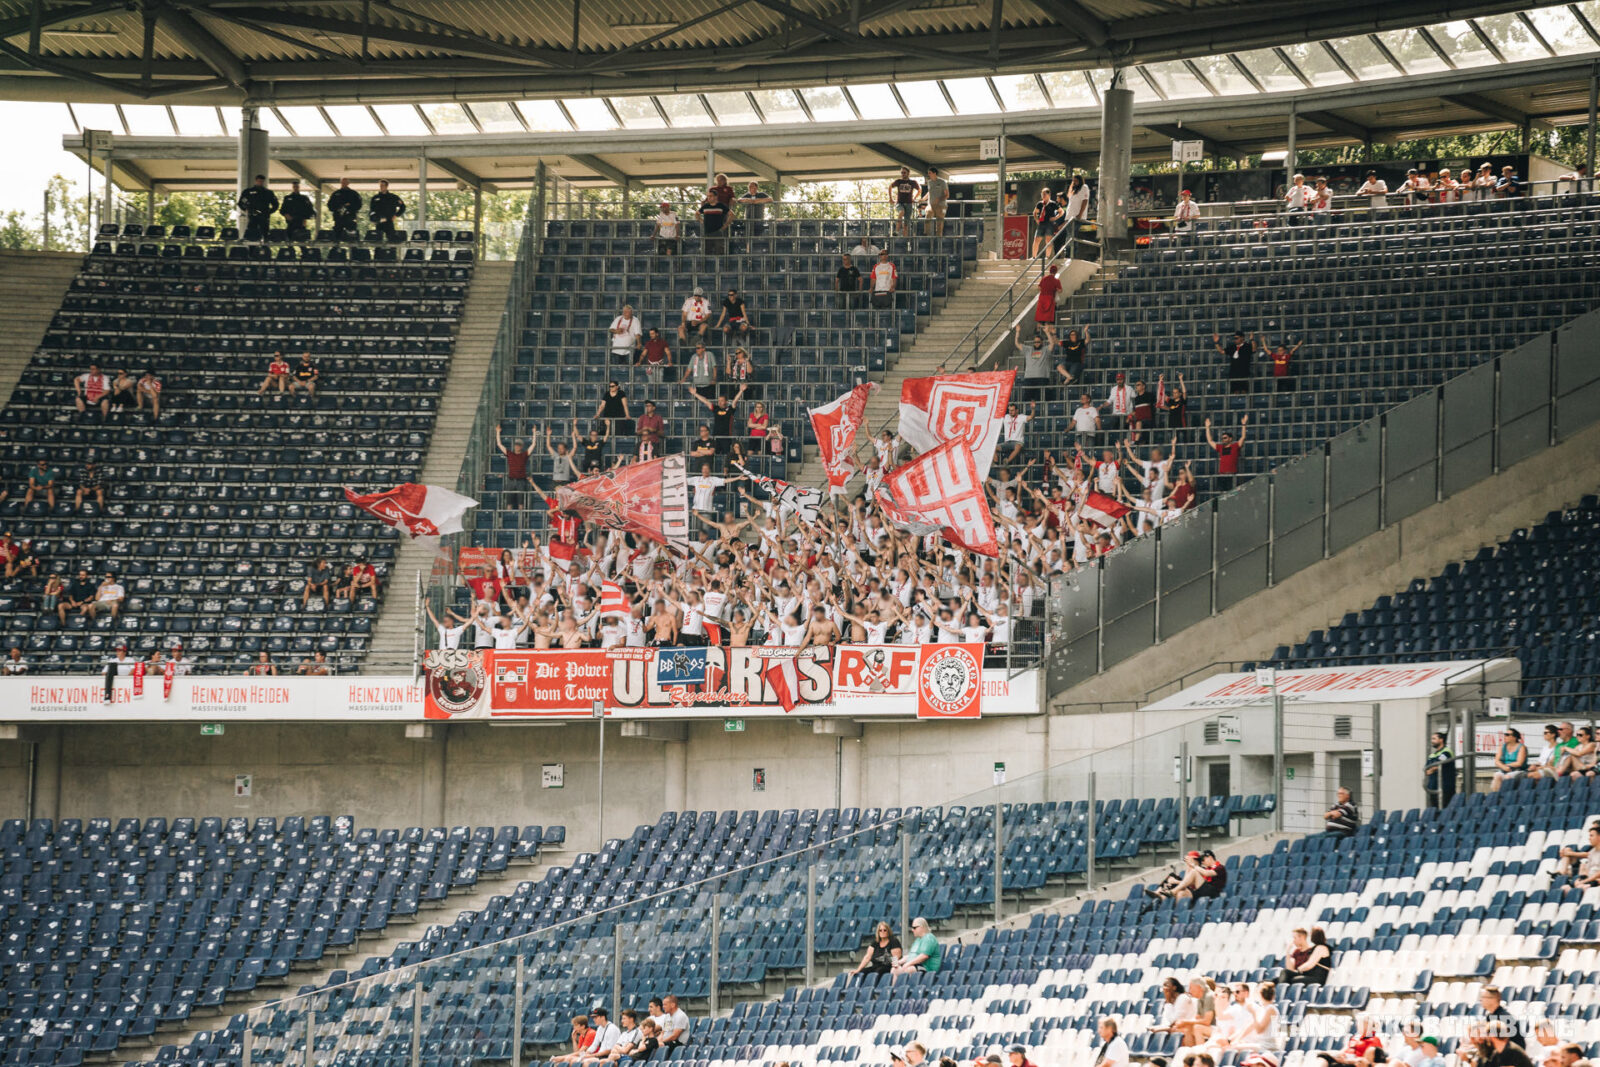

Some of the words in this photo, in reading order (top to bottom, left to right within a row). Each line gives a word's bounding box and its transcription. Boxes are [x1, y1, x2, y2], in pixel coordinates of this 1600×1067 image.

[425, 649, 468, 669] JGS
[660, 658, 674, 672] BB
[690, 658, 705, 671] 95
[535, 662, 560, 679] Die
[564, 661, 609, 681] Power
[31, 685, 64, 703] HEINZ
[67, 688, 88, 703] VON
[91, 685, 131, 703] HEDEN
[192, 685, 224, 703] HEINZ
[226, 688, 247, 703] VON
[250, 685, 289, 703] HEIDEN
[348, 685, 380, 703] HEINZ
[383, 687, 403, 703] VON
[406, 685, 424, 703] HEI
[534, 685, 561, 701] vom
[564, 683, 609, 701] Tower
[669, 686, 749, 707] Regensburg
[981, 680, 1009, 697] EIDEN
